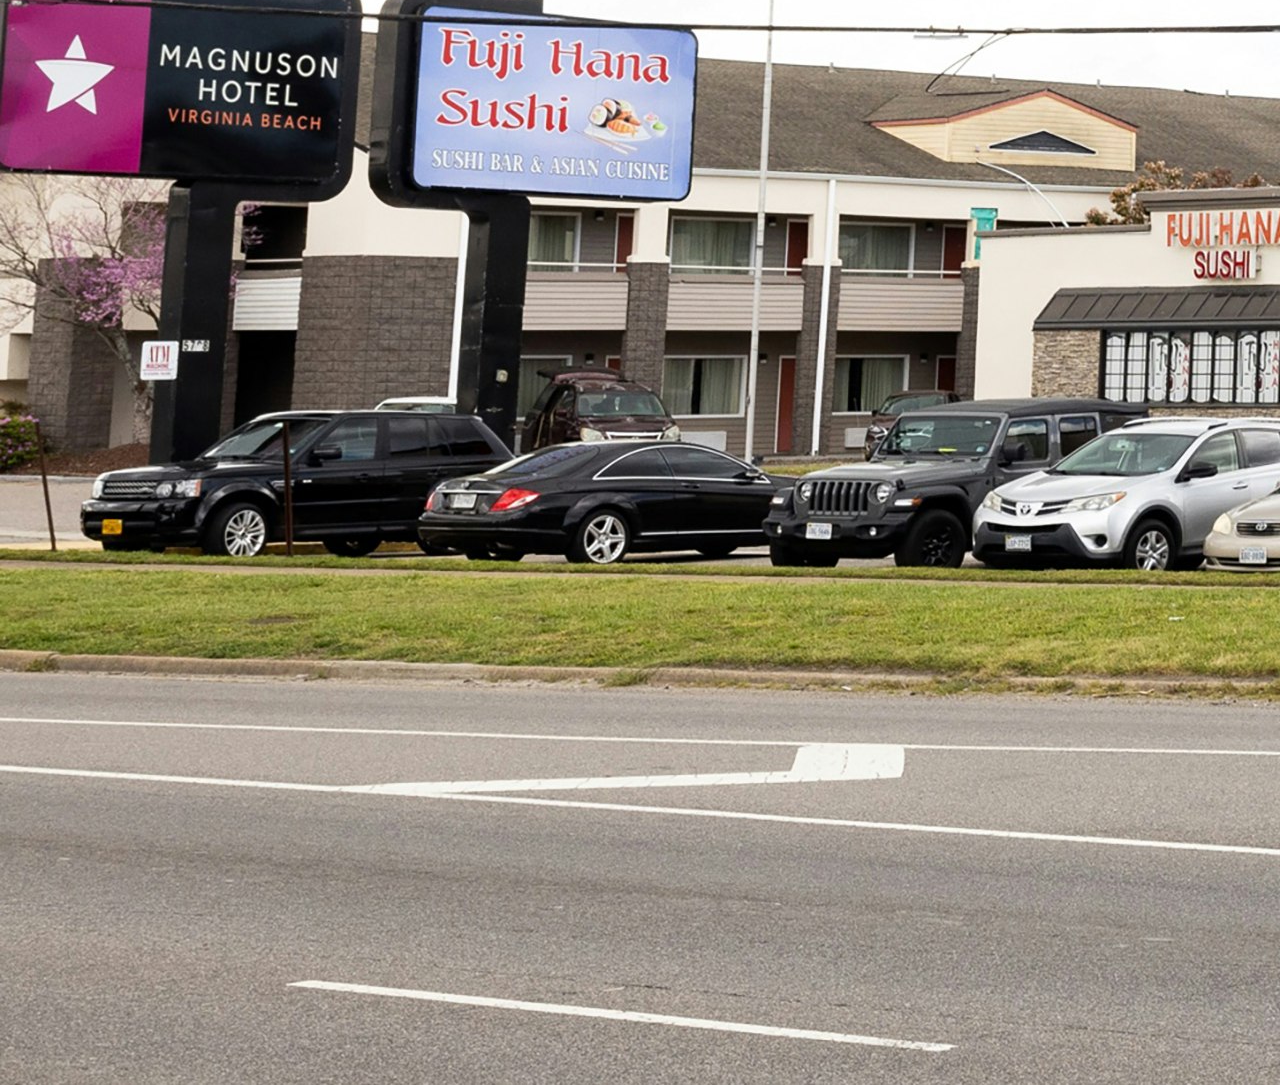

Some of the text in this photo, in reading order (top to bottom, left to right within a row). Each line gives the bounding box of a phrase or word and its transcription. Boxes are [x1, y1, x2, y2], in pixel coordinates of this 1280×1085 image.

[159, 43, 338, 79] MAGNUSON
[438, 27, 671, 83] Fuji Hana
[198, 78, 299, 107] HOTEL
[168, 108, 322, 131] VIRGINIA BEACH
[435, 89, 570, 133] Sushi
[432, 150, 671, 181] SUSHI BAR & ASIAN CUISINE
[1167, 212, 1212, 247] FUJI
[1193, 250, 1251, 279] SUSHI
[150, 345, 170, 363] ATM
